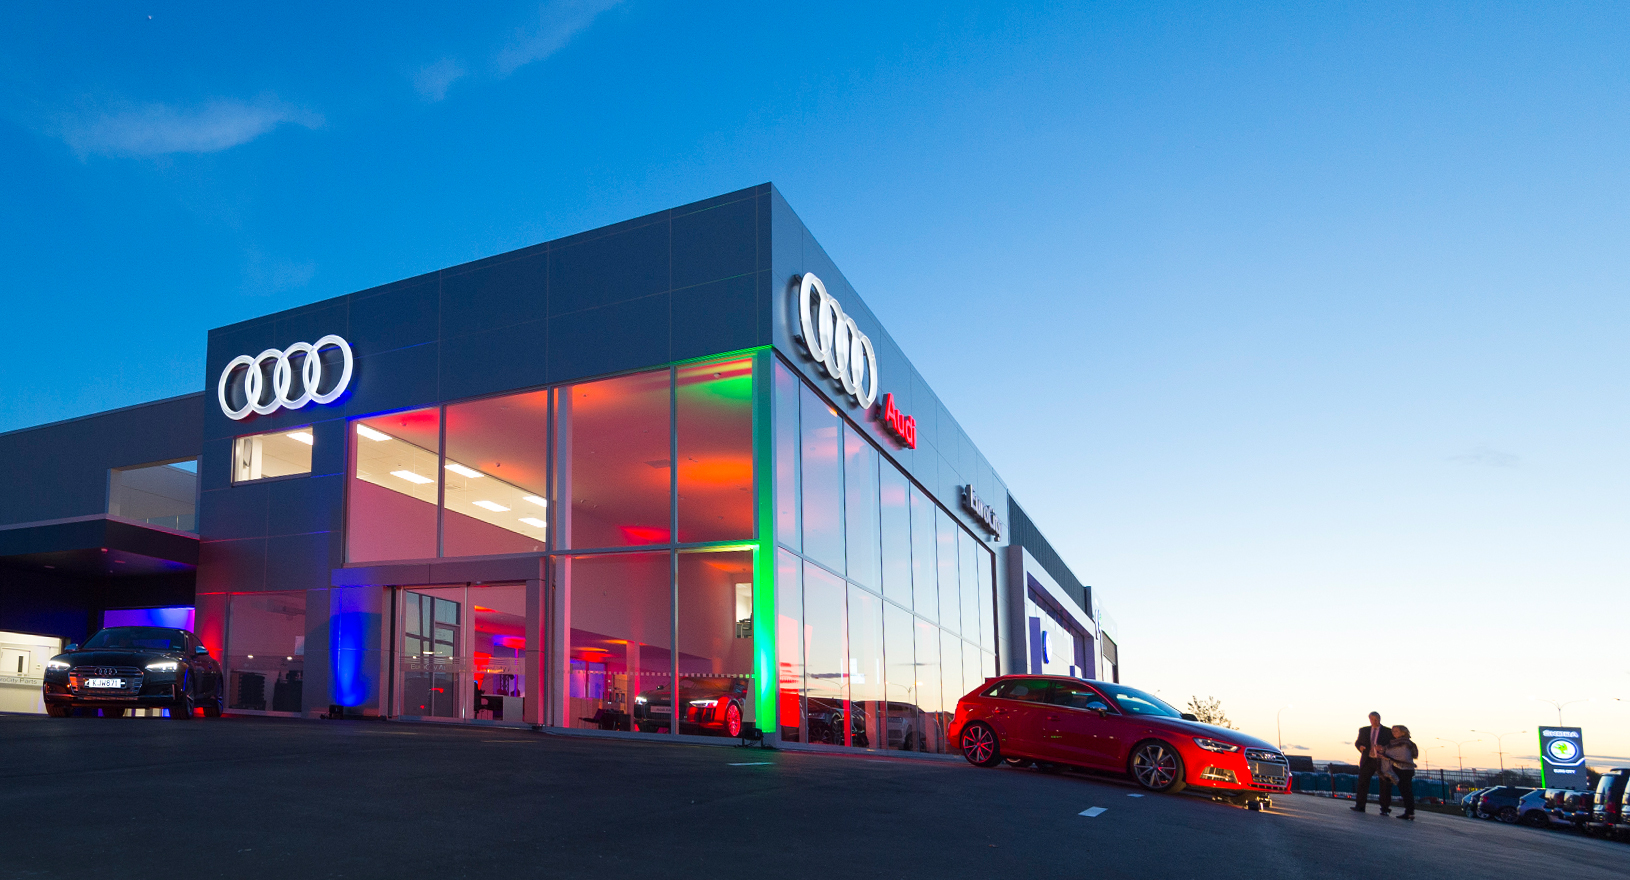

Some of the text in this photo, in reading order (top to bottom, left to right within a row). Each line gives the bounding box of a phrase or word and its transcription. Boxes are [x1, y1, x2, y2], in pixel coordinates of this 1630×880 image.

[883, 392, 917, 450] Audi
[20, 677, 37, 685] Parts
[92, 679, 118, 687] KJW871
